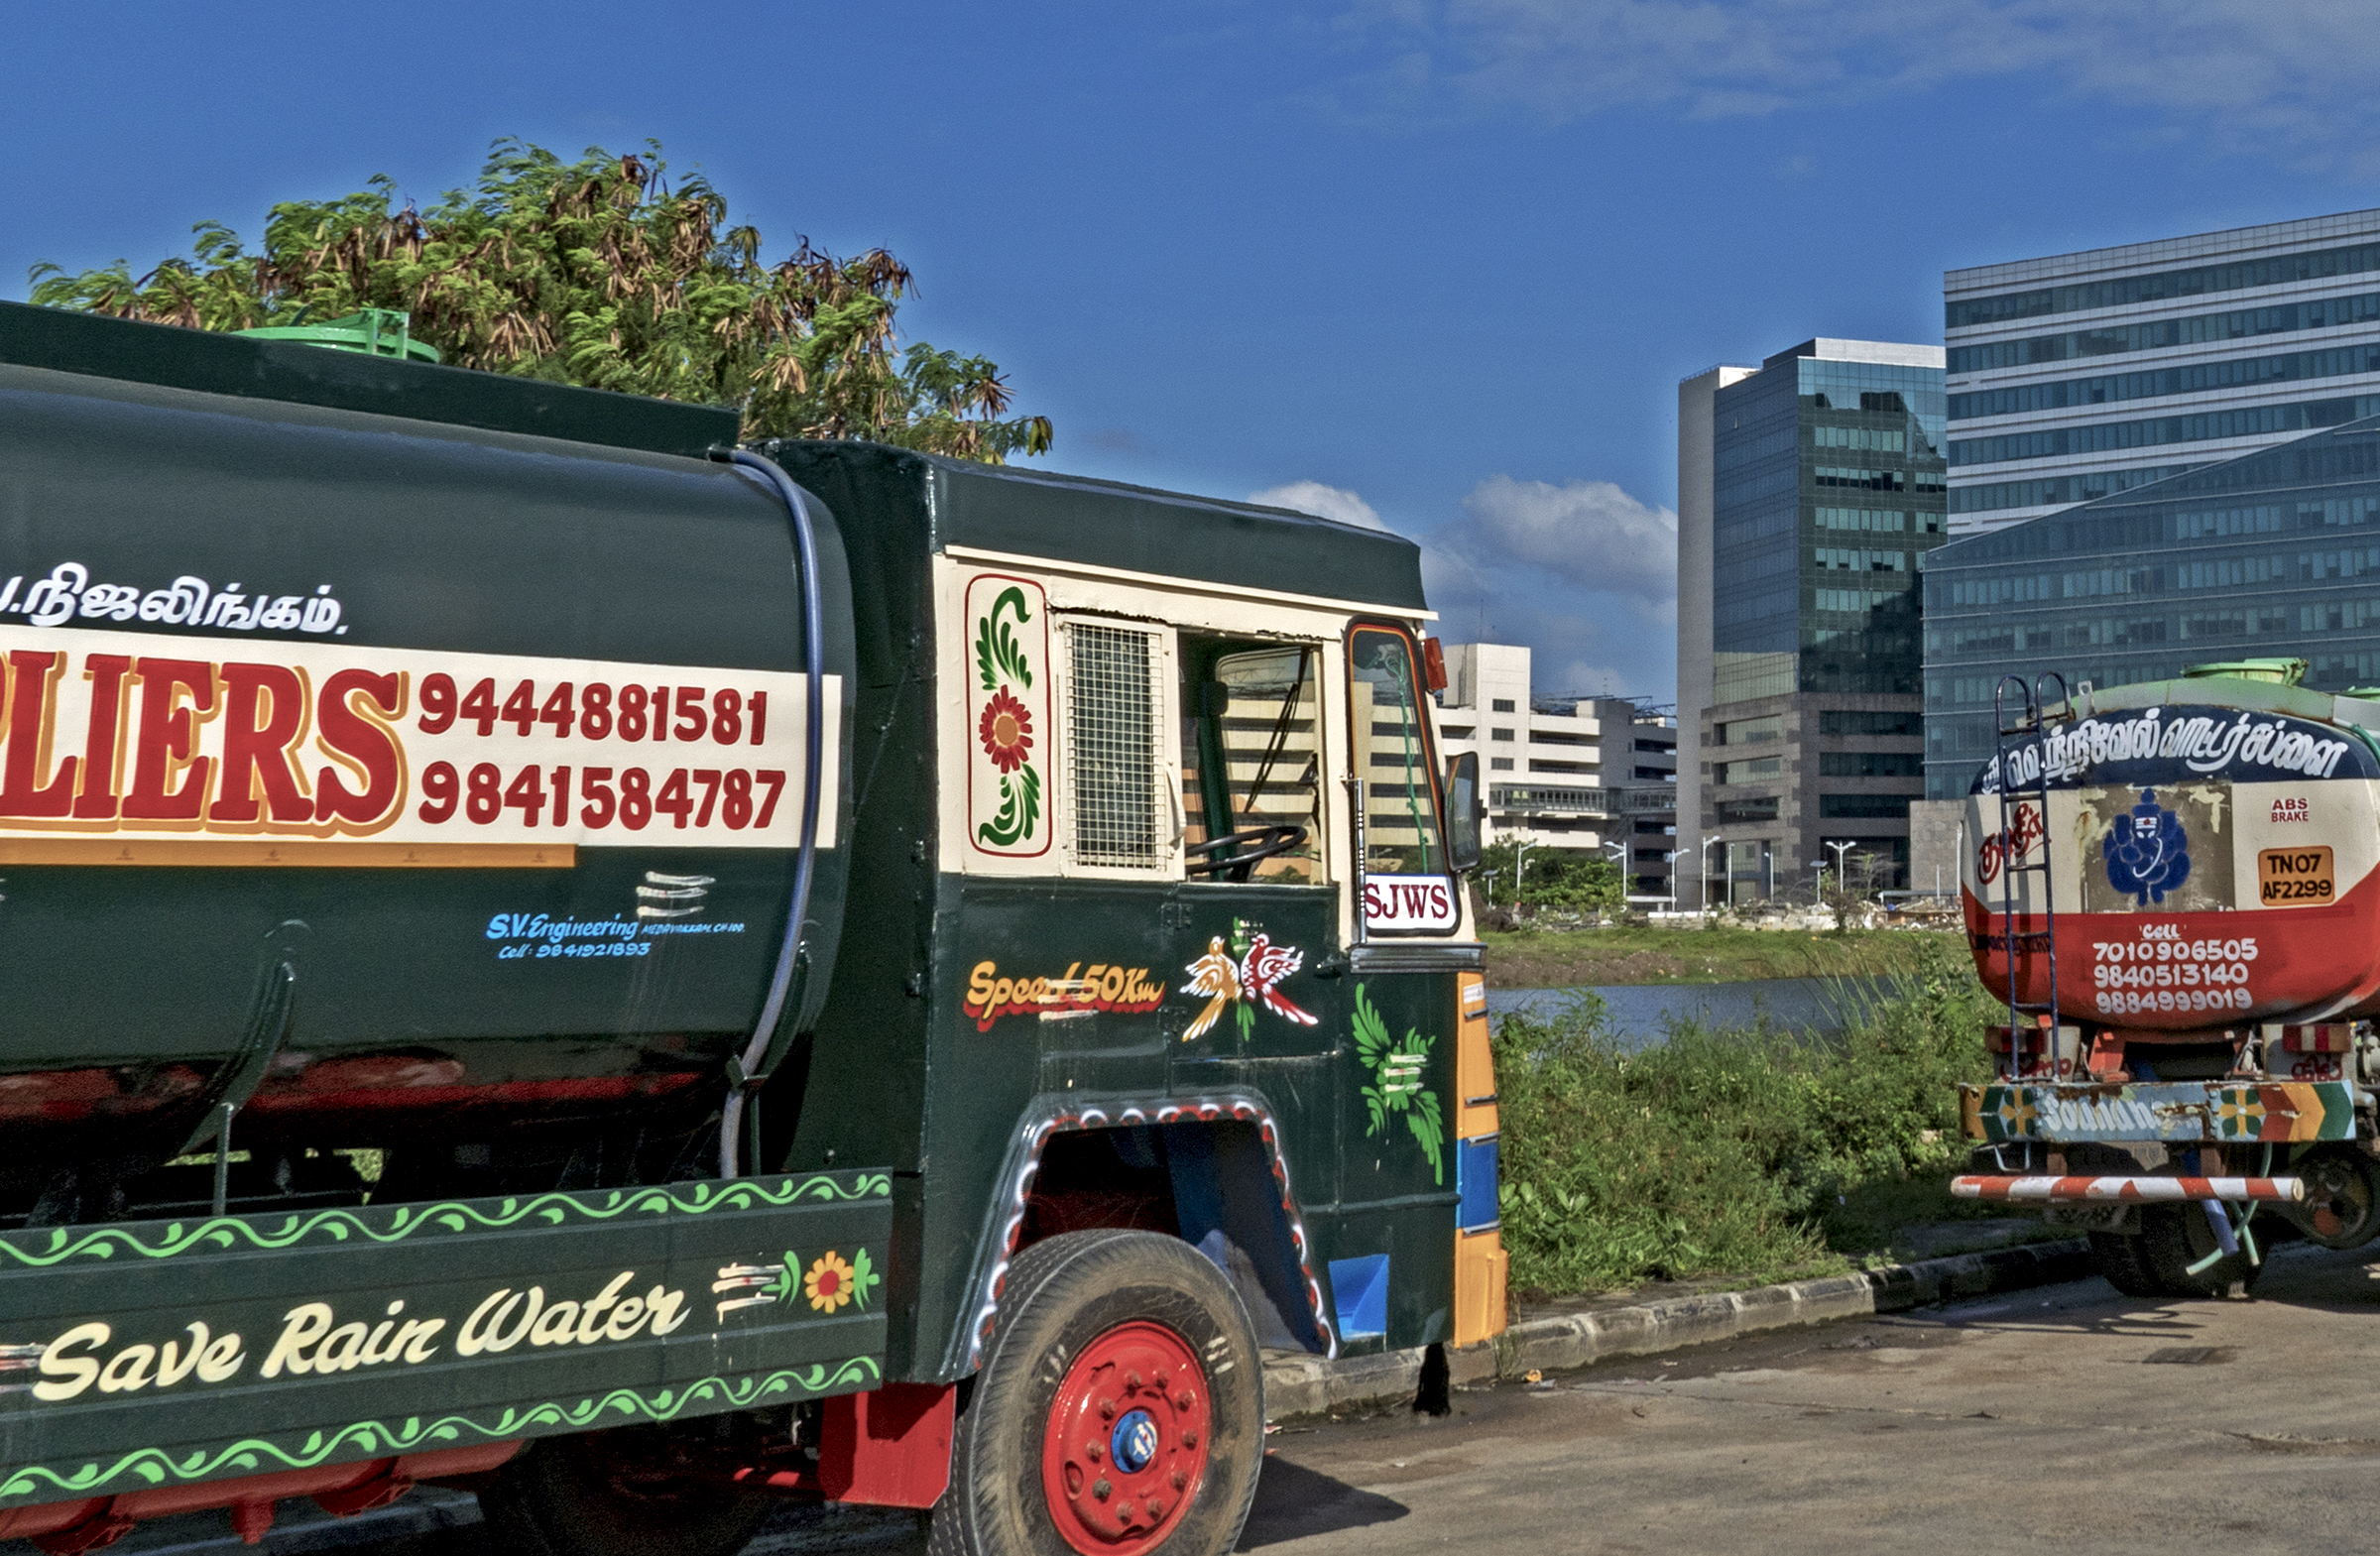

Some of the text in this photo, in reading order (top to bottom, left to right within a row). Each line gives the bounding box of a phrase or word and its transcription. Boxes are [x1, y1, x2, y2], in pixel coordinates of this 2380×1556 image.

[417, 672, 768, 746] 9444881581
[0, 650, 410, 838] LIERS
[417, 761, 786, 830] 9841584787
[2272, 798, 2308, 811] ABS
[2271, 811, 2309, 823] BRAKE
[1365, 883, 1449, 919] SJWS
[2263, 880, 2332, 900] AF2299
[536, 943, 652, 958] 9841921893
[2092, 938, 2258, 962] 7010906505
[2094, 962, 2249, 989] 9840513140
[2095, 987, 2253, 1015] 9884999019
[32, 1270, 692, 1402] Save Rain Water
